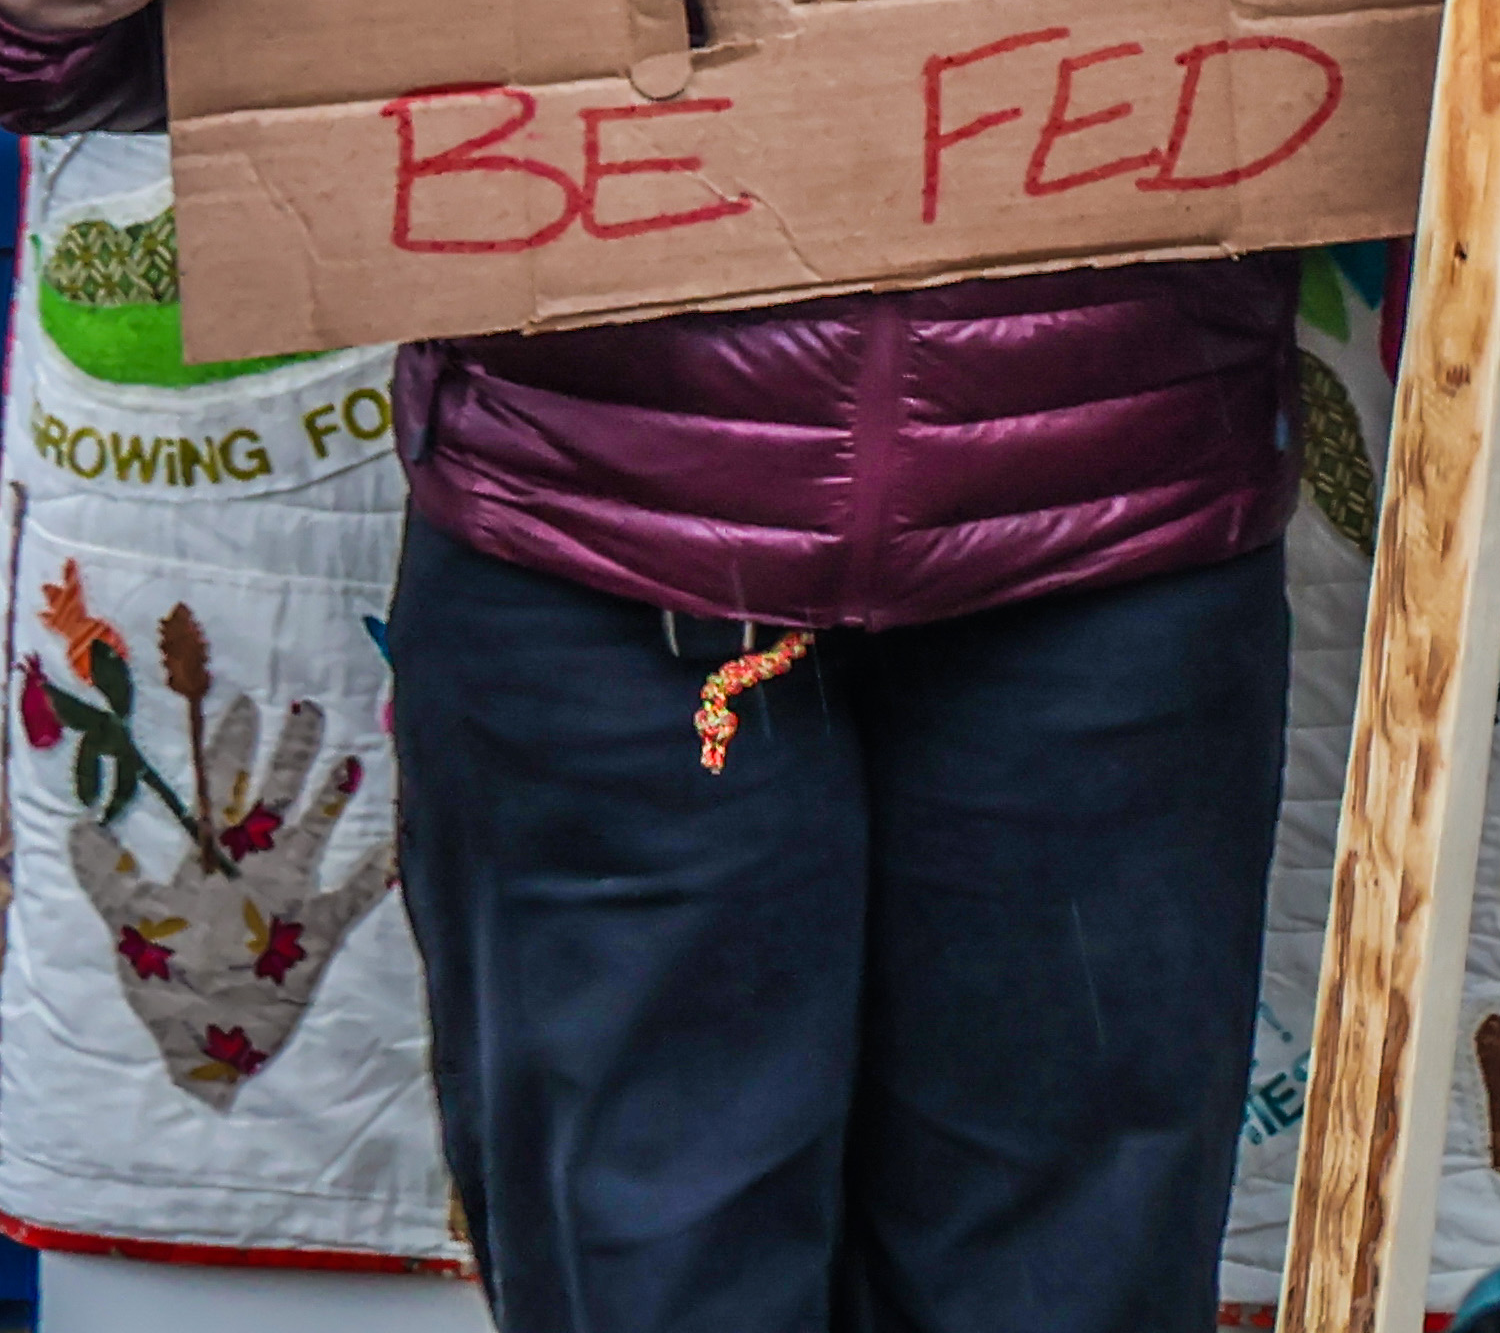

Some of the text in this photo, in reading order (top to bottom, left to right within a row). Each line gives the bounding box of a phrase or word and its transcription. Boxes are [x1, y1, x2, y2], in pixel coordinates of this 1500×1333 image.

[382, 27, 1346, 253] BE FED
[31, 378, 393, 488] ROWiNG FO
